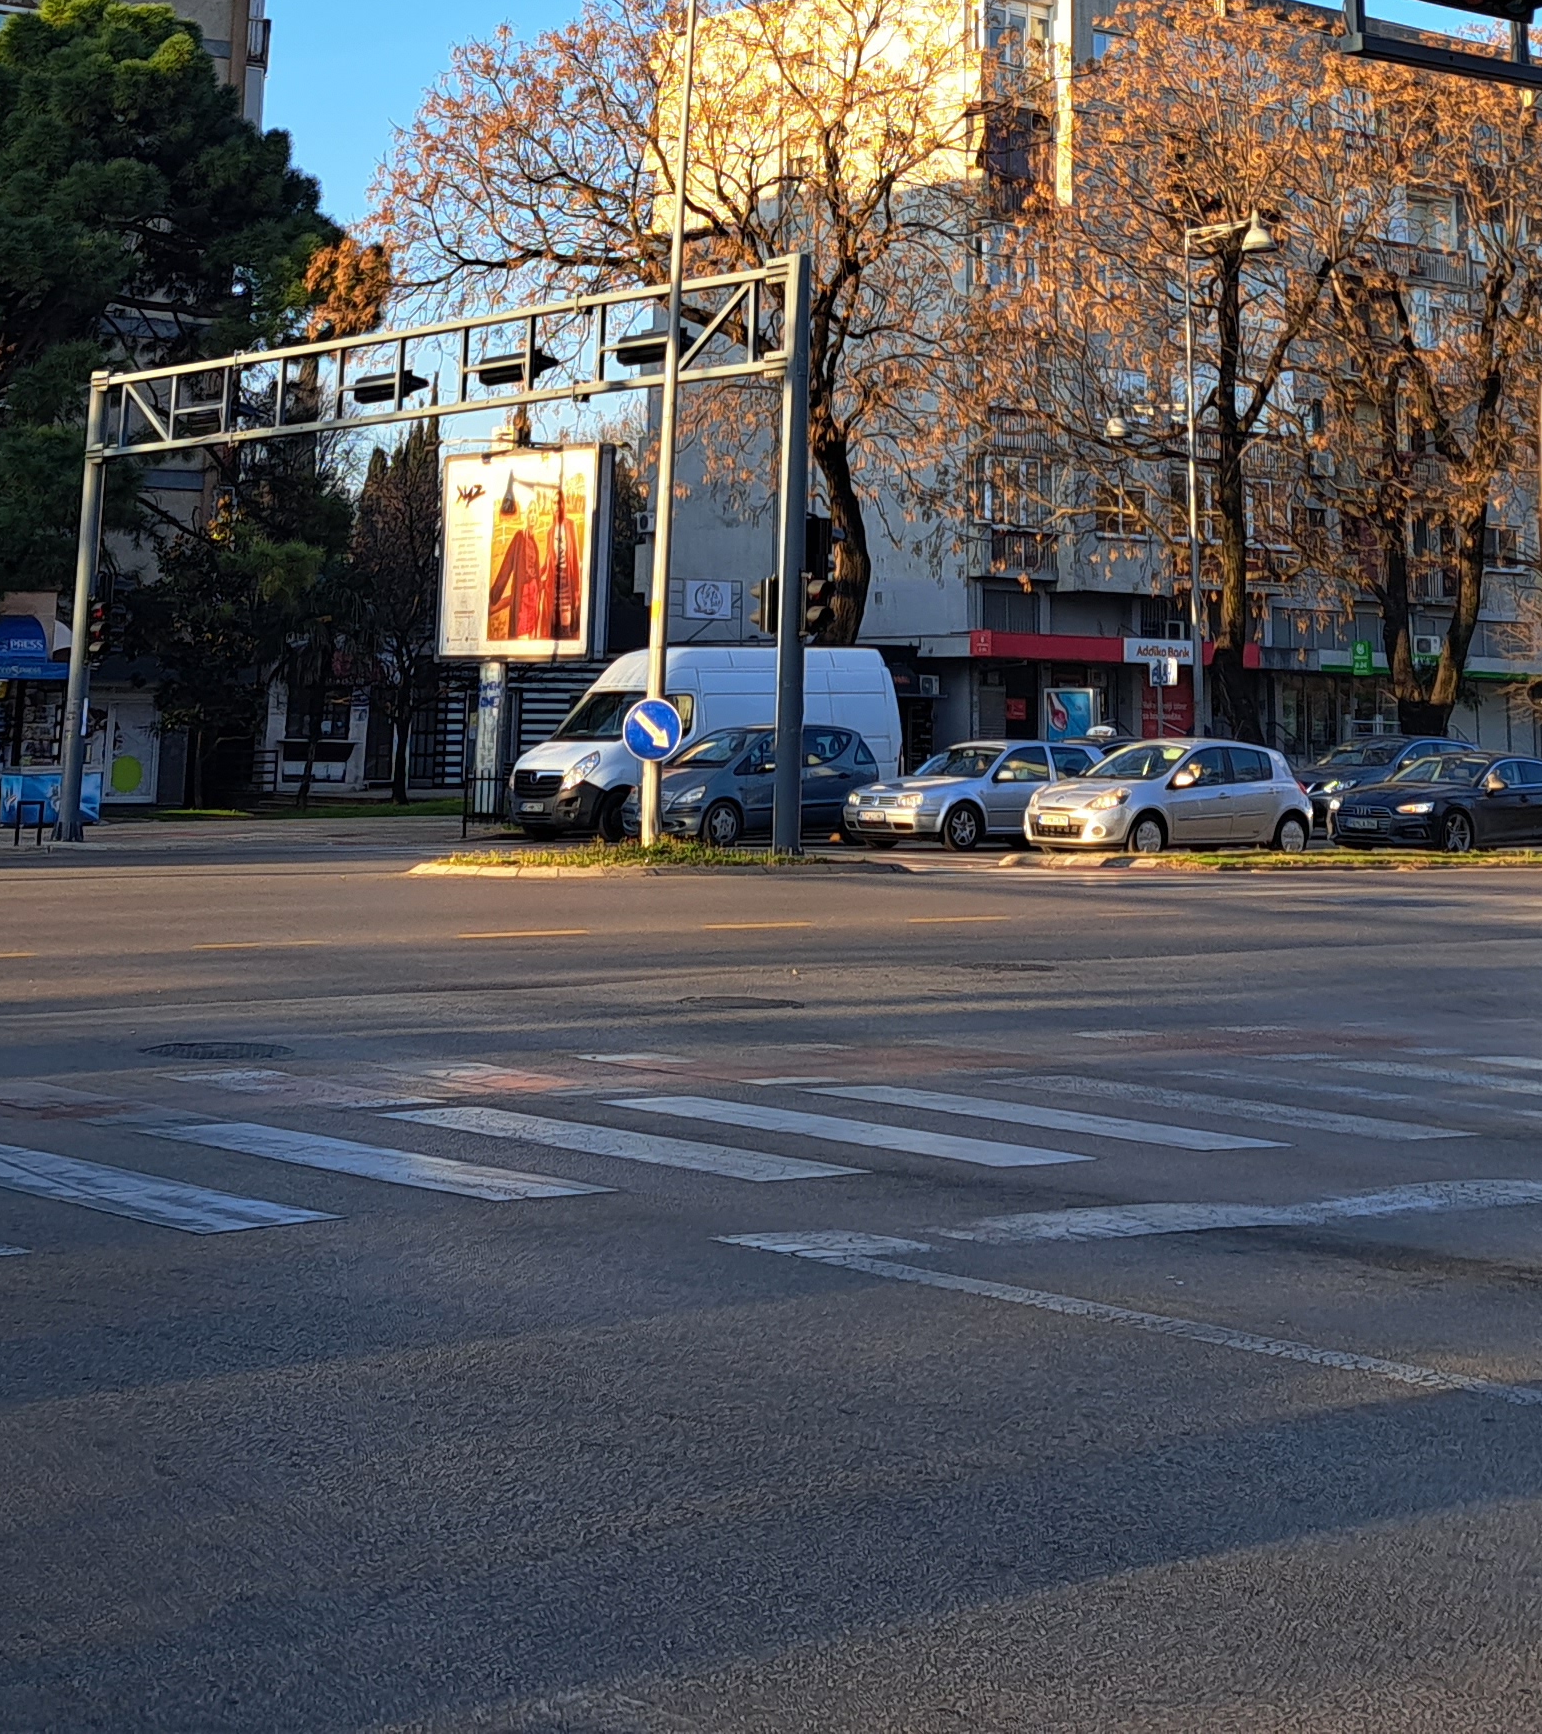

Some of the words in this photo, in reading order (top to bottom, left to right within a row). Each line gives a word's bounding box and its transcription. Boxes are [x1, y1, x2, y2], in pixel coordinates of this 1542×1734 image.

[9, 638, 44, 650] PRESS
[1136, 644, 1167, 657] Addiko
[1167, 647, 1190, 659] Bank
